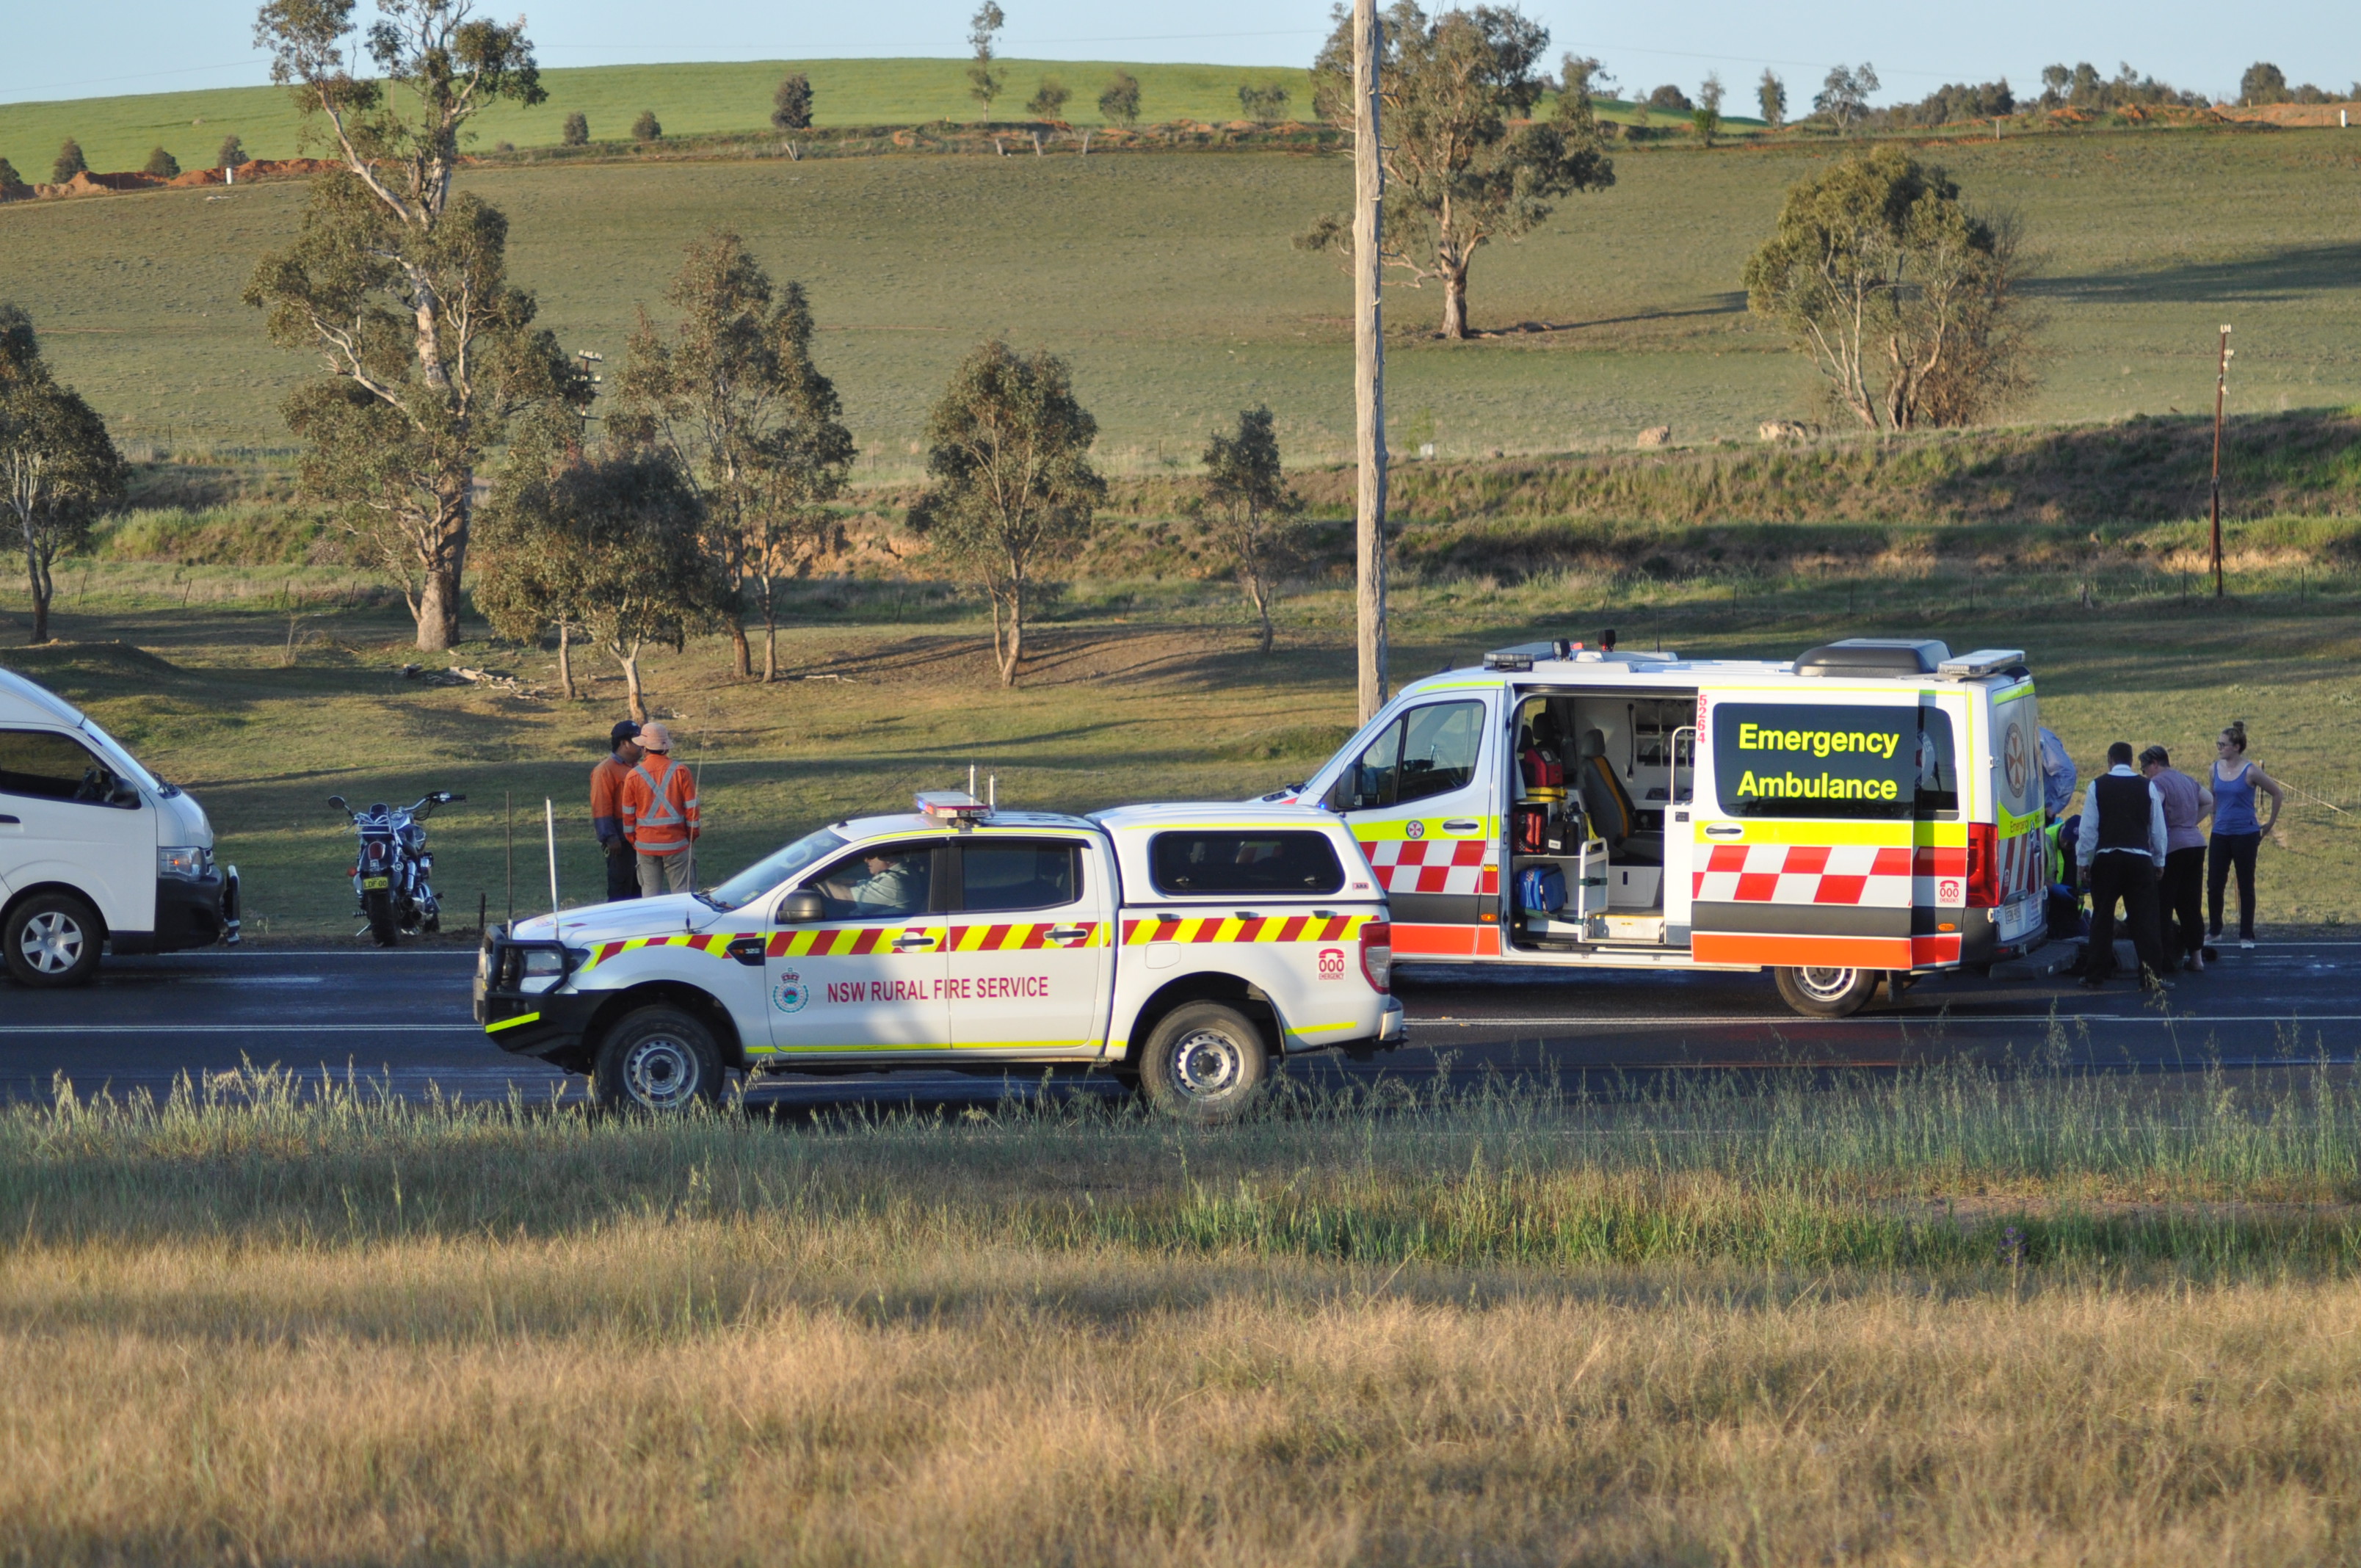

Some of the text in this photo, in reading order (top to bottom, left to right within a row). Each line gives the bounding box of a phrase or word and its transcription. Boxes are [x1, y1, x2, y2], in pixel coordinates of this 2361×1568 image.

[1697, 694, 1708, 744] 5264
[1738, 722, 1900, 759] Emergency
[1736, 770, 1898, 800] Ambulance
[1940, 888, 1959, 898] 000
[1319, 959, 1345, 973] 000
[827, 981, 866, 1003] NSW
[871, 979, 929, 1001] RURAL
[934, 978, 971, 999] FIRE
[976, 976, 1048, 998] SERVICE
